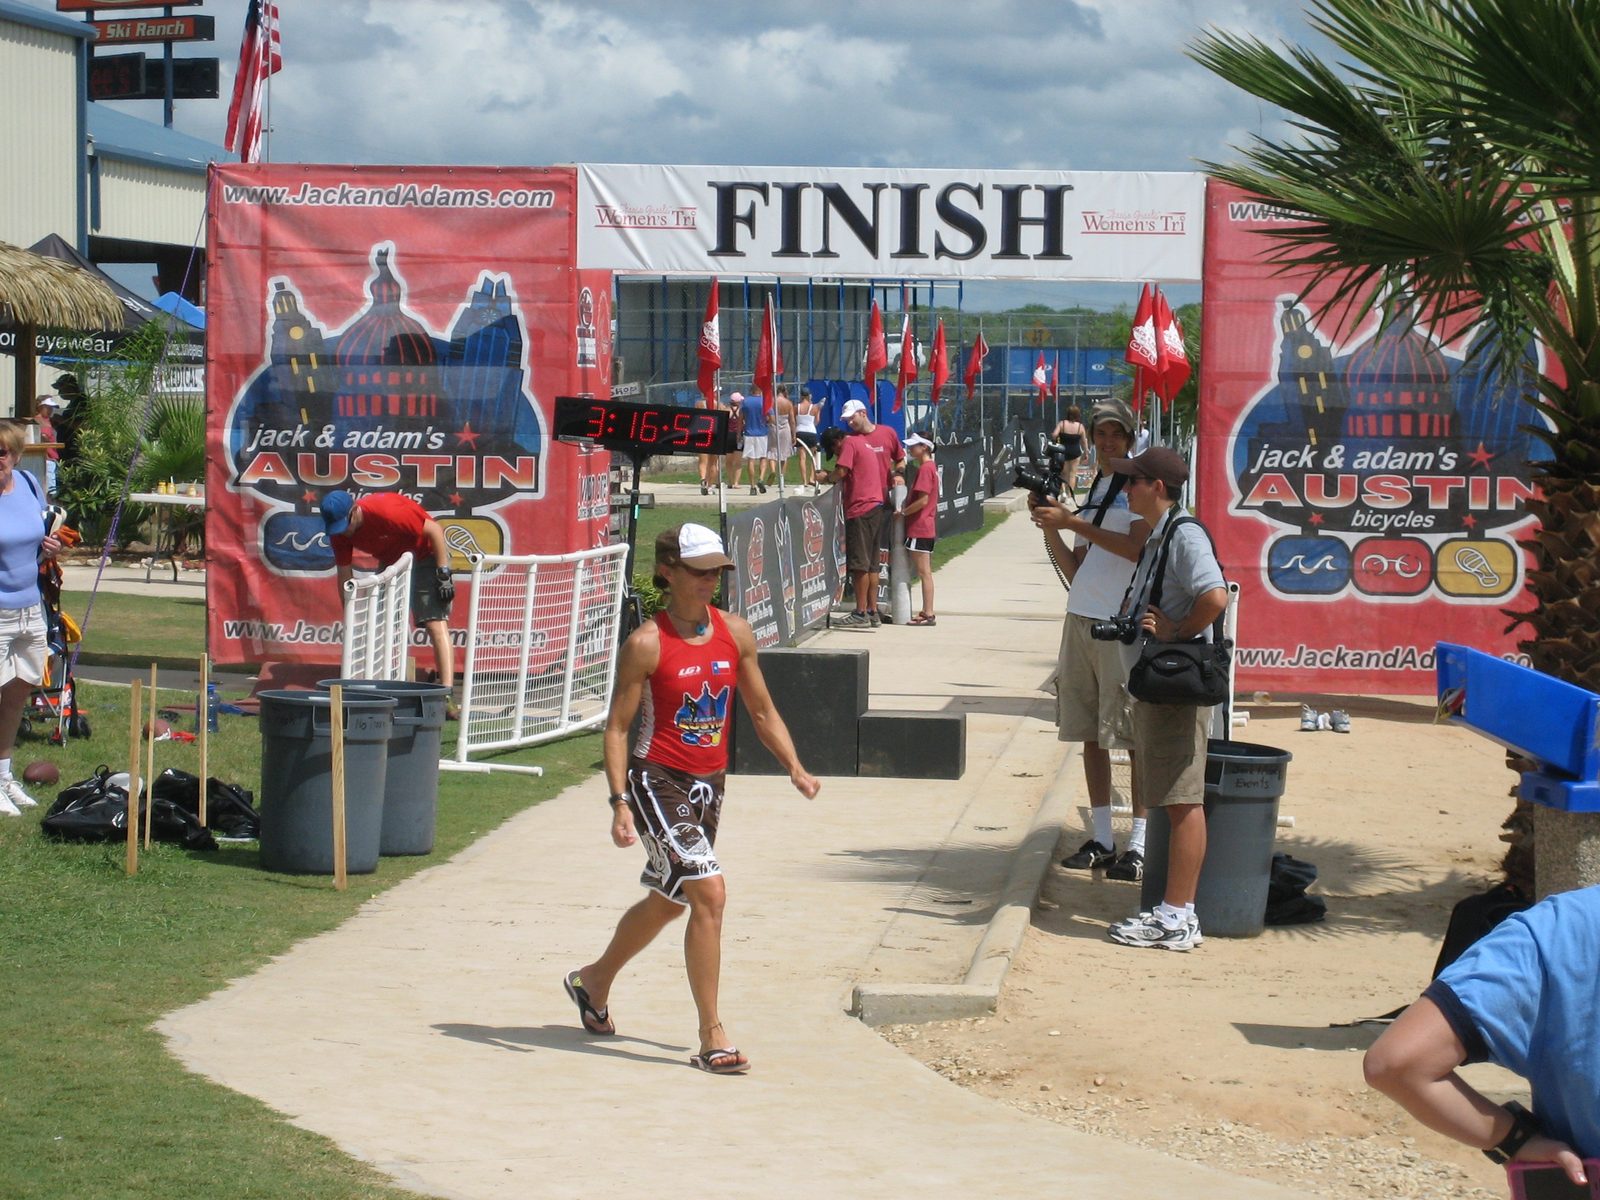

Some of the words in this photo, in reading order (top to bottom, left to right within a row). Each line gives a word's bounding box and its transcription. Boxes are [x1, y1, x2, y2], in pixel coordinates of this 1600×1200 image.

[106, 23, 131, 39] Ski
[135, 20, 185, 37] Ranch
[223, 183, 554, 207] www.JackandAdams.com
[596, 208, 668, 226] Women's
[671, 210, 696, 226] Tri
[707, 180, 1074, 260] FINISH
[1083, 215, 1156, 231] Women's
[1160, 214, 1185, 232] Tri
[35, 334, 114, 353] eyewear
[246, 424, 309, 451] jack
[314, 424, 336, 447] &
[343, 425, 445, 450] adam's
[238, 451, 538, 489] AUSTIN
[1250, 444, 1318, 473] jack
[1323, 444, 1345, 469] &
[1352, 446, 1458, 471] adam's
[1242, 473, 1549, 510] AUSTIN
[1351, 510, 1435, 531] bicycles
